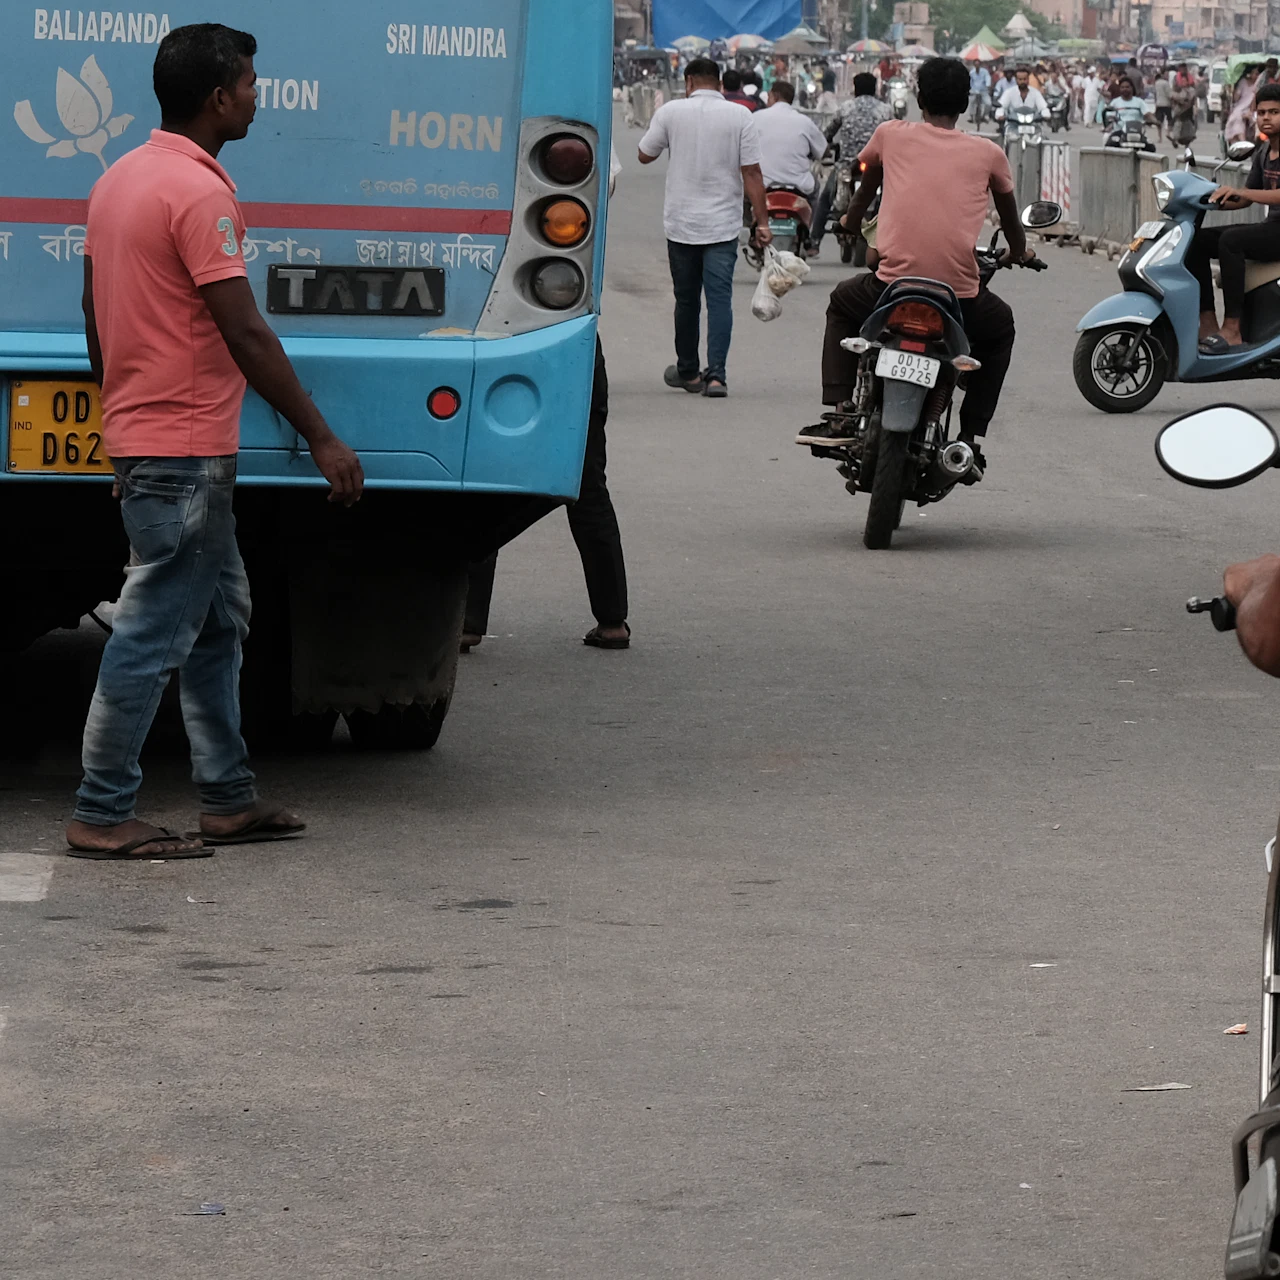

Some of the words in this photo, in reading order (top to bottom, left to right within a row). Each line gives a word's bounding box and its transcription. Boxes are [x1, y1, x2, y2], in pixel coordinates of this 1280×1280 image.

[34, 8, 171, 44] BALIAPANDA
[386, 23, 417, 55] SRI
[422, 25, 507, 58] MANDIRA
[389, 110, 503, 152] HORN
[217, 217, 239, 256] 3
[277, 268, 436, 310] TATA
[891, 365, 931, 385] G9725
[898, 353, 931, 371] OD13
[53, 391, 92, 423] OD
[14, 421, 33, 431] IND
[42, 431, 102, 465] D62
